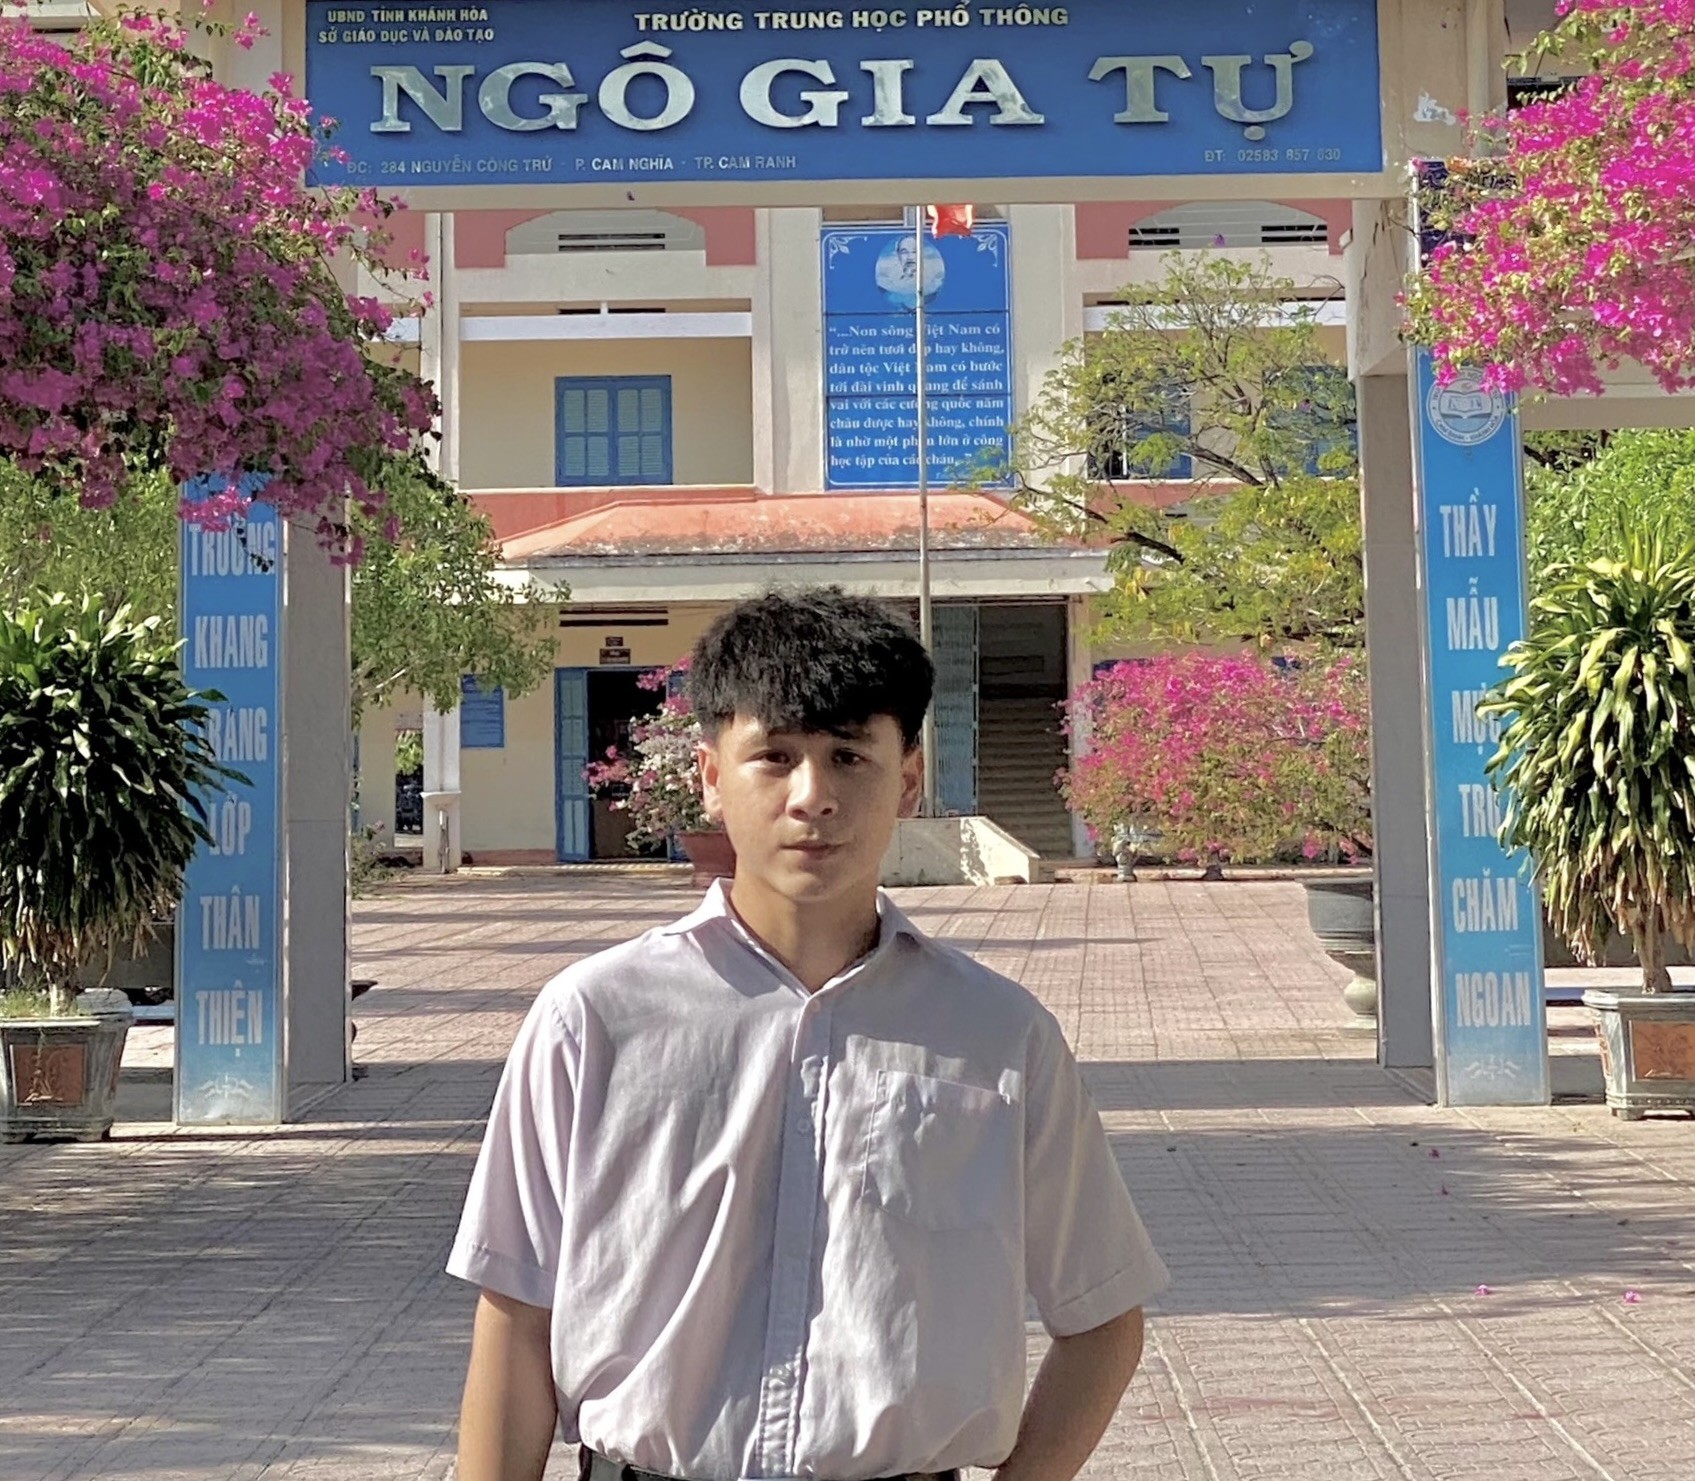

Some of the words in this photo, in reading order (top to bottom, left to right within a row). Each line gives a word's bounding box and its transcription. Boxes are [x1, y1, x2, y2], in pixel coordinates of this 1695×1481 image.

[328, 10, 366, 22] UBND
[408, 7, 456, 22] KHÁNH
[634, 8, 743, 31] TRƯỜNG
[754, 11, 843, 29] TRUNG
[852, 10, 907, 32] HỌC
[916, 0, 971, 27] PHỔ
[979, 3, 1068, 26] THÔNG
[318, 26, 338, 42] SỞ
[343, 27, 375, 42] GIÁO
[380, 30, 408, 45] DỤC
[413, 26, 429, 42] VÀ
[435, 26, 462, 42] ĐÀO
[467, 29, 494, 44] TẠO
[370, 40, 695, 132] NGÔ
[740, 58, 1045, 128] GIA
[1088, 40, 1314, 140] TỰ
[411, 154, 471, 173] NGUYỄN
[477, 156, 518, 172] CÔNG
[591, 158, 623, 170] CAM
[629, 154, 674, 170] NGHĨA
[694, 157, 714, 169] TP.
[719, 156, 750, 168] CAM
[755, 156, 796, 168] RANH
[1286, 149, 1309, 160] 857
[949, 324, 981, 336] Nam
[985, 324, 1000, 334] có
[908, 343, 932, 358] đp
[936, 343, 957, 356] hay
[860, 362, 879, 376] tộc
[883, 362, 910, 376] Việt
[969, 360, 1003, 372] bước
[875, 380, 904, 392] vinh
[908, 381, 949, 394] qang
[971, 378, 1003, 391] sánh
[830, 398, 849, 410] vai
[875, 398, 896, 410] các
[941, 394, 972, 412] quốc
[968, 415, 1004, 427] chính
[830, 436, 842, 447] là
[874, 435, 898, 449] một
[902, 434, 934, 449] phn
[831, 454, 851, 469] học
[1440, 488, 1496, 558] THẦY
[1446, 577, 1499, 650] MẪU
[194, 615, 268, 668] KHANG
[209, 790, 250, 856] LỚP
[1452, 867, 1518, 933] CHĂM
[200, 884, 260, 950] THÂN
[1455, 972, 1531, 1028] NGOAN
[196, 980, 262, 1057] THIỆN
